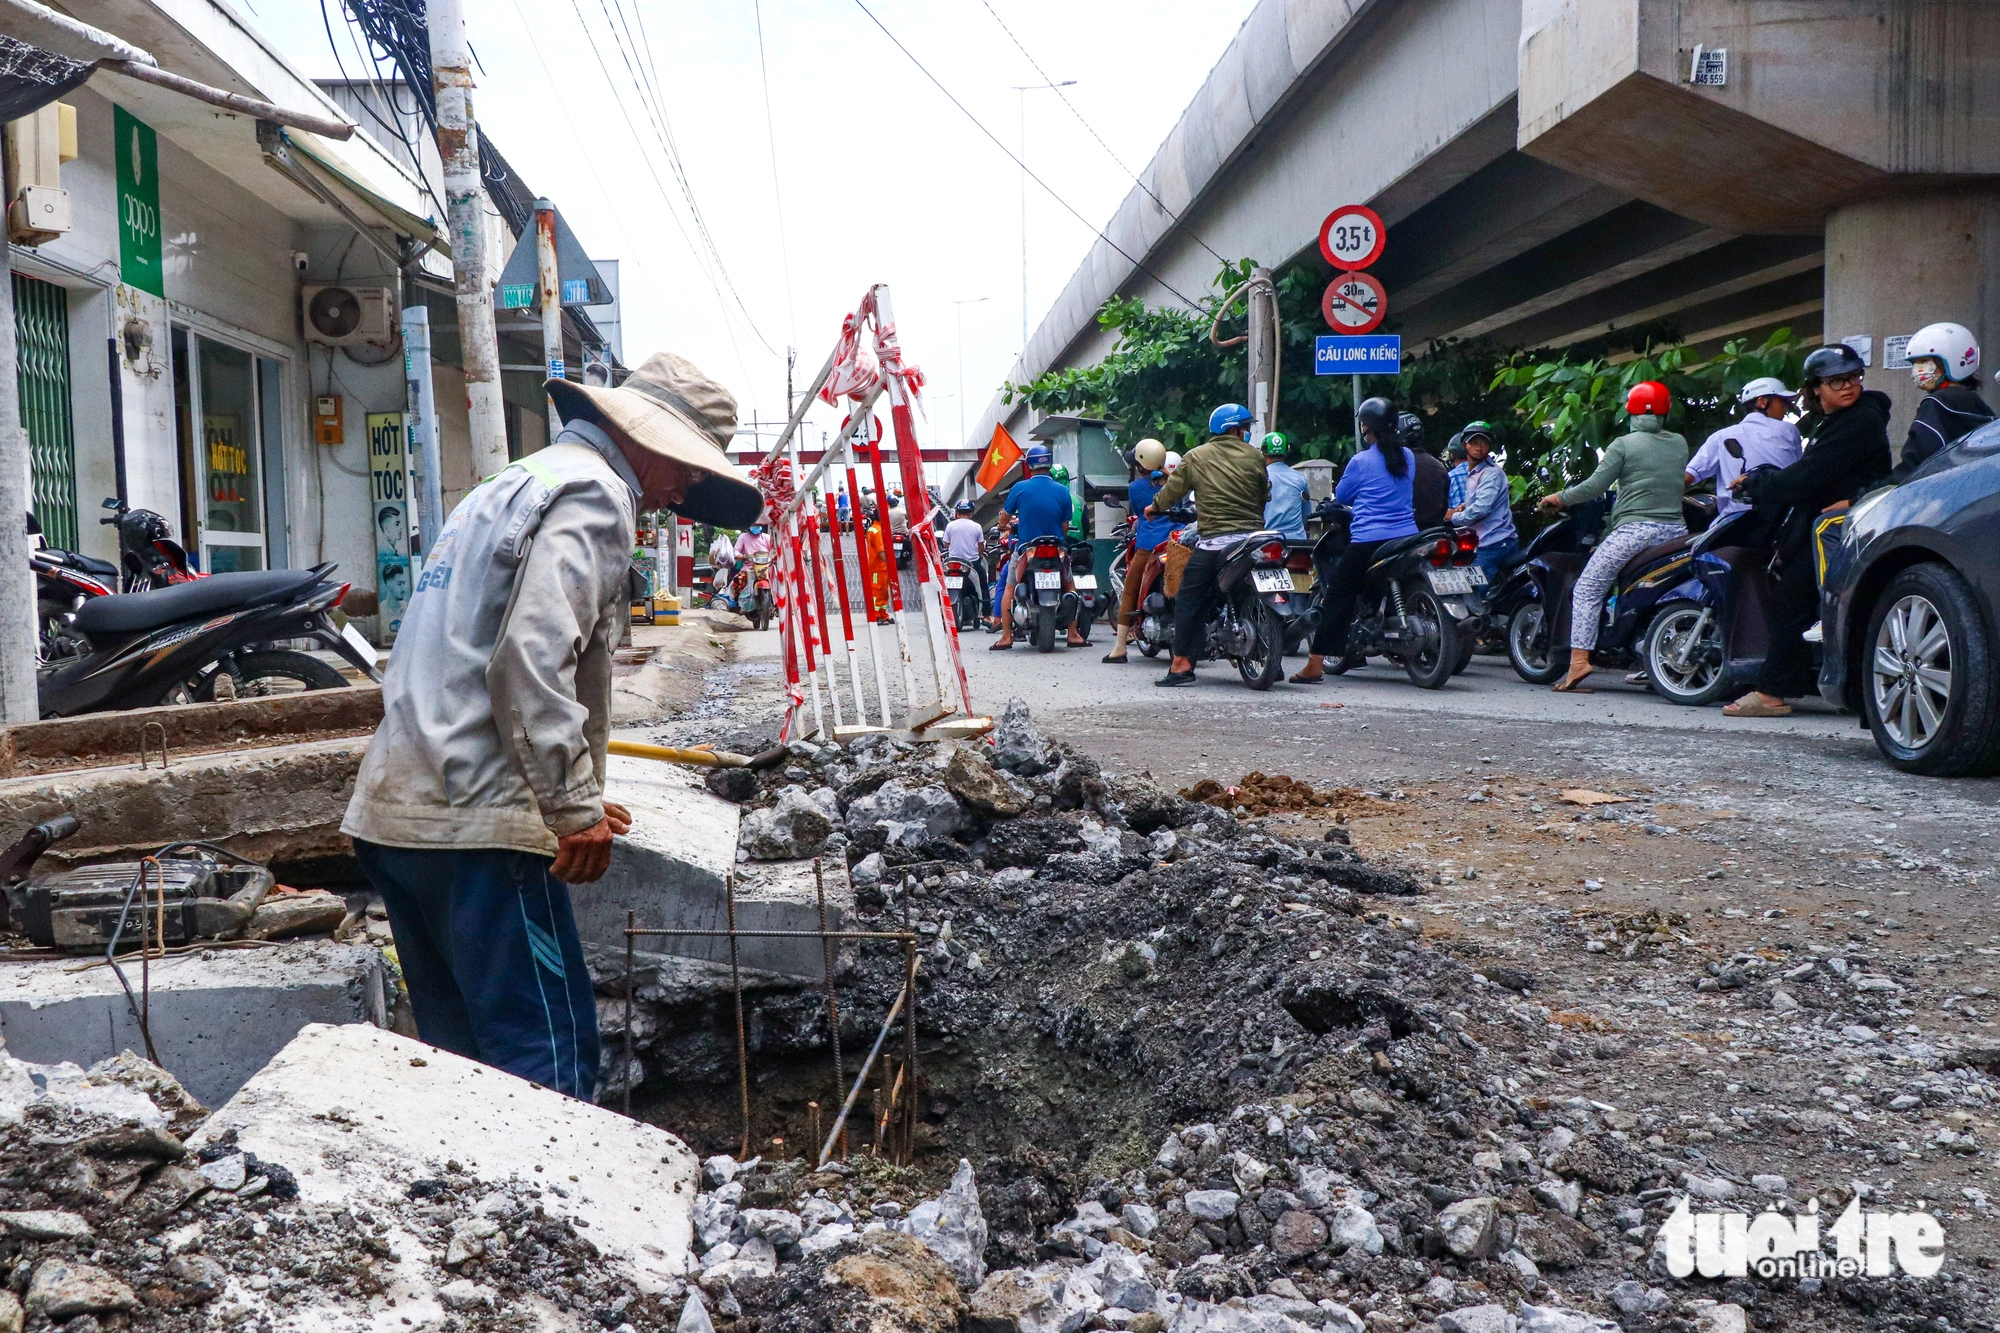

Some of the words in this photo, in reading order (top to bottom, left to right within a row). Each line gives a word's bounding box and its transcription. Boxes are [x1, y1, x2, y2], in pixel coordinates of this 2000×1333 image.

[1709, 74, 1724, 84] 559
[1317, 344, 1341, 361] CẦU
[1343, 347, 1367, 361] LONG
[1369, 343, 1397, 361] KIỂNG
[371, 417, 400, 456] HỚT
[373, 462, 403, 500] TÓC
